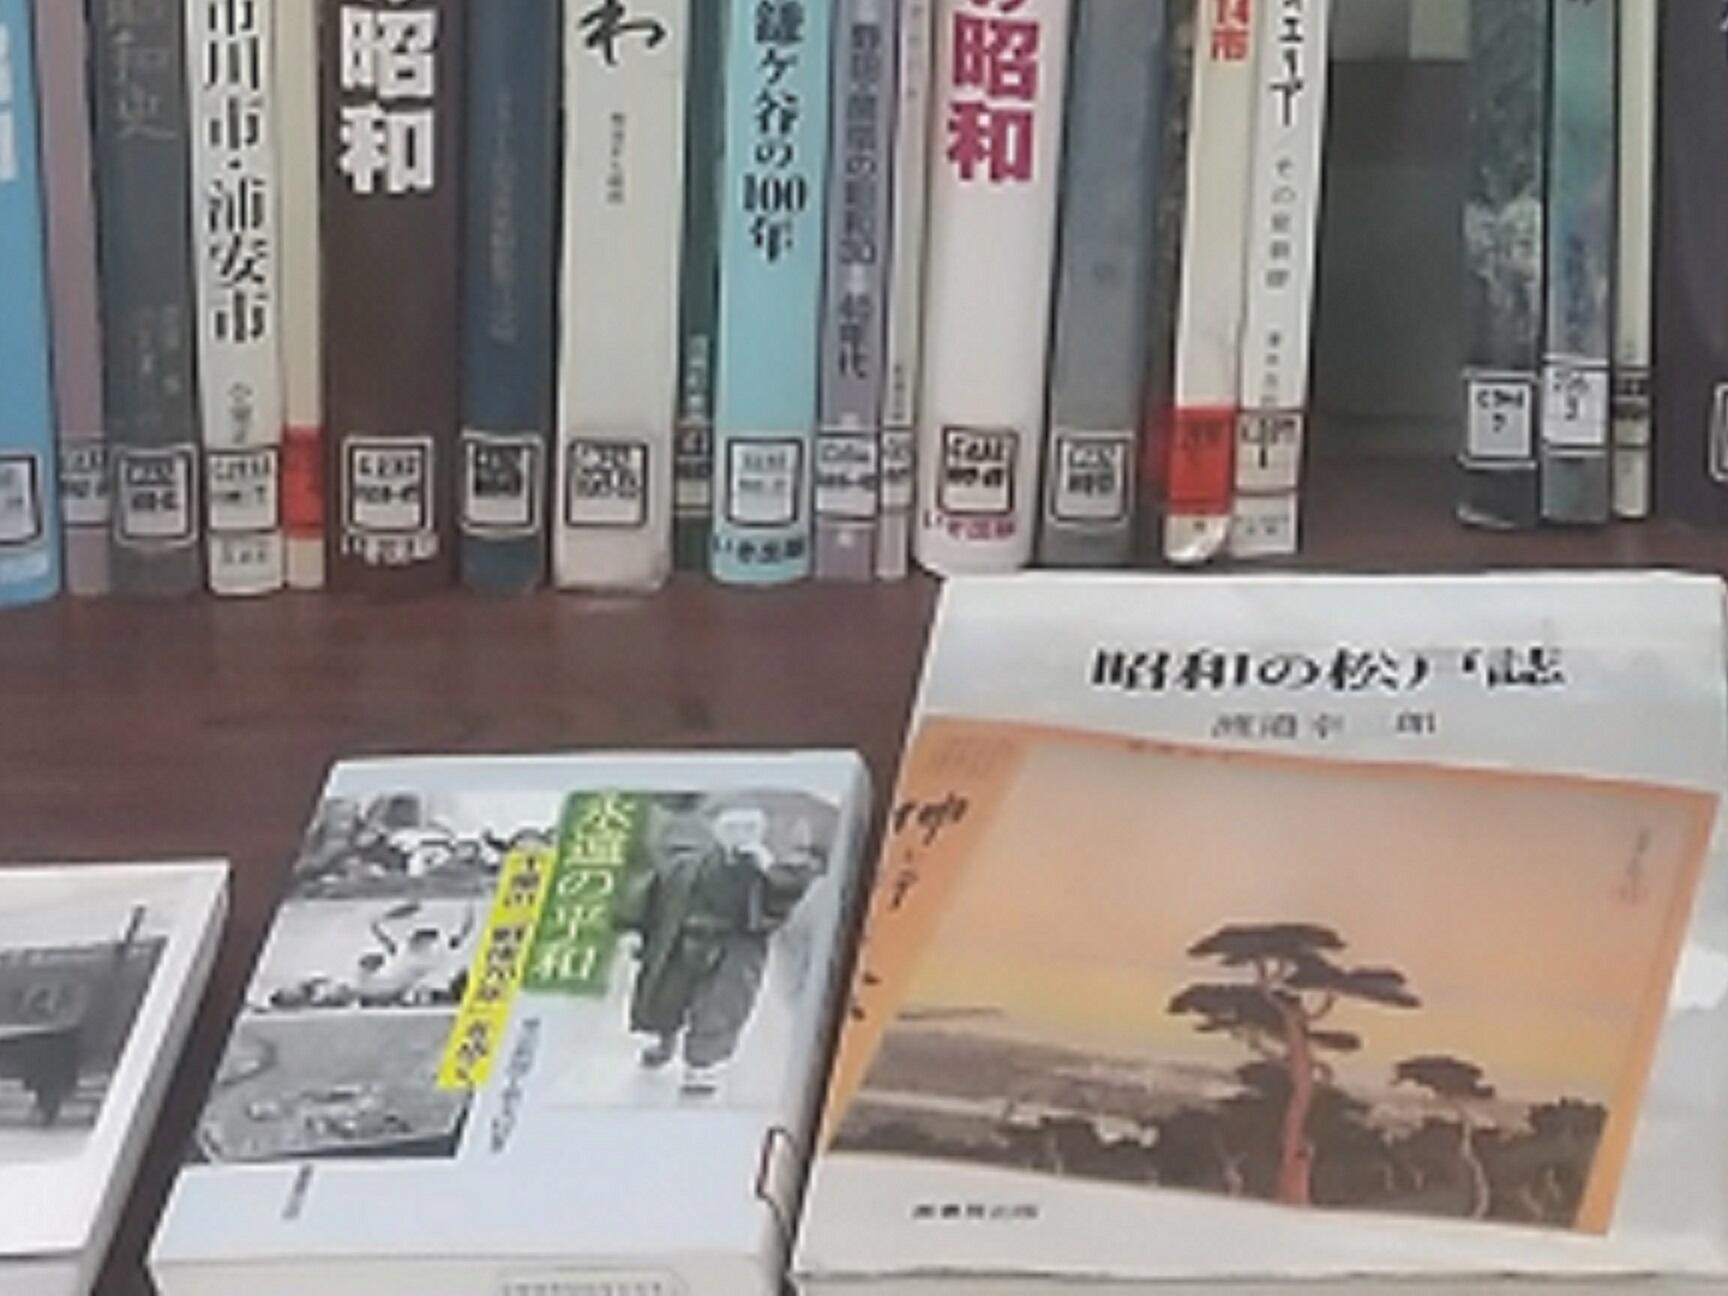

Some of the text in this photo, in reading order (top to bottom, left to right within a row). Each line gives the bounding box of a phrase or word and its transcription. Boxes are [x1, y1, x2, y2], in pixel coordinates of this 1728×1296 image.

[1089, 644, 1568, 694] 昭和の松戸誌
